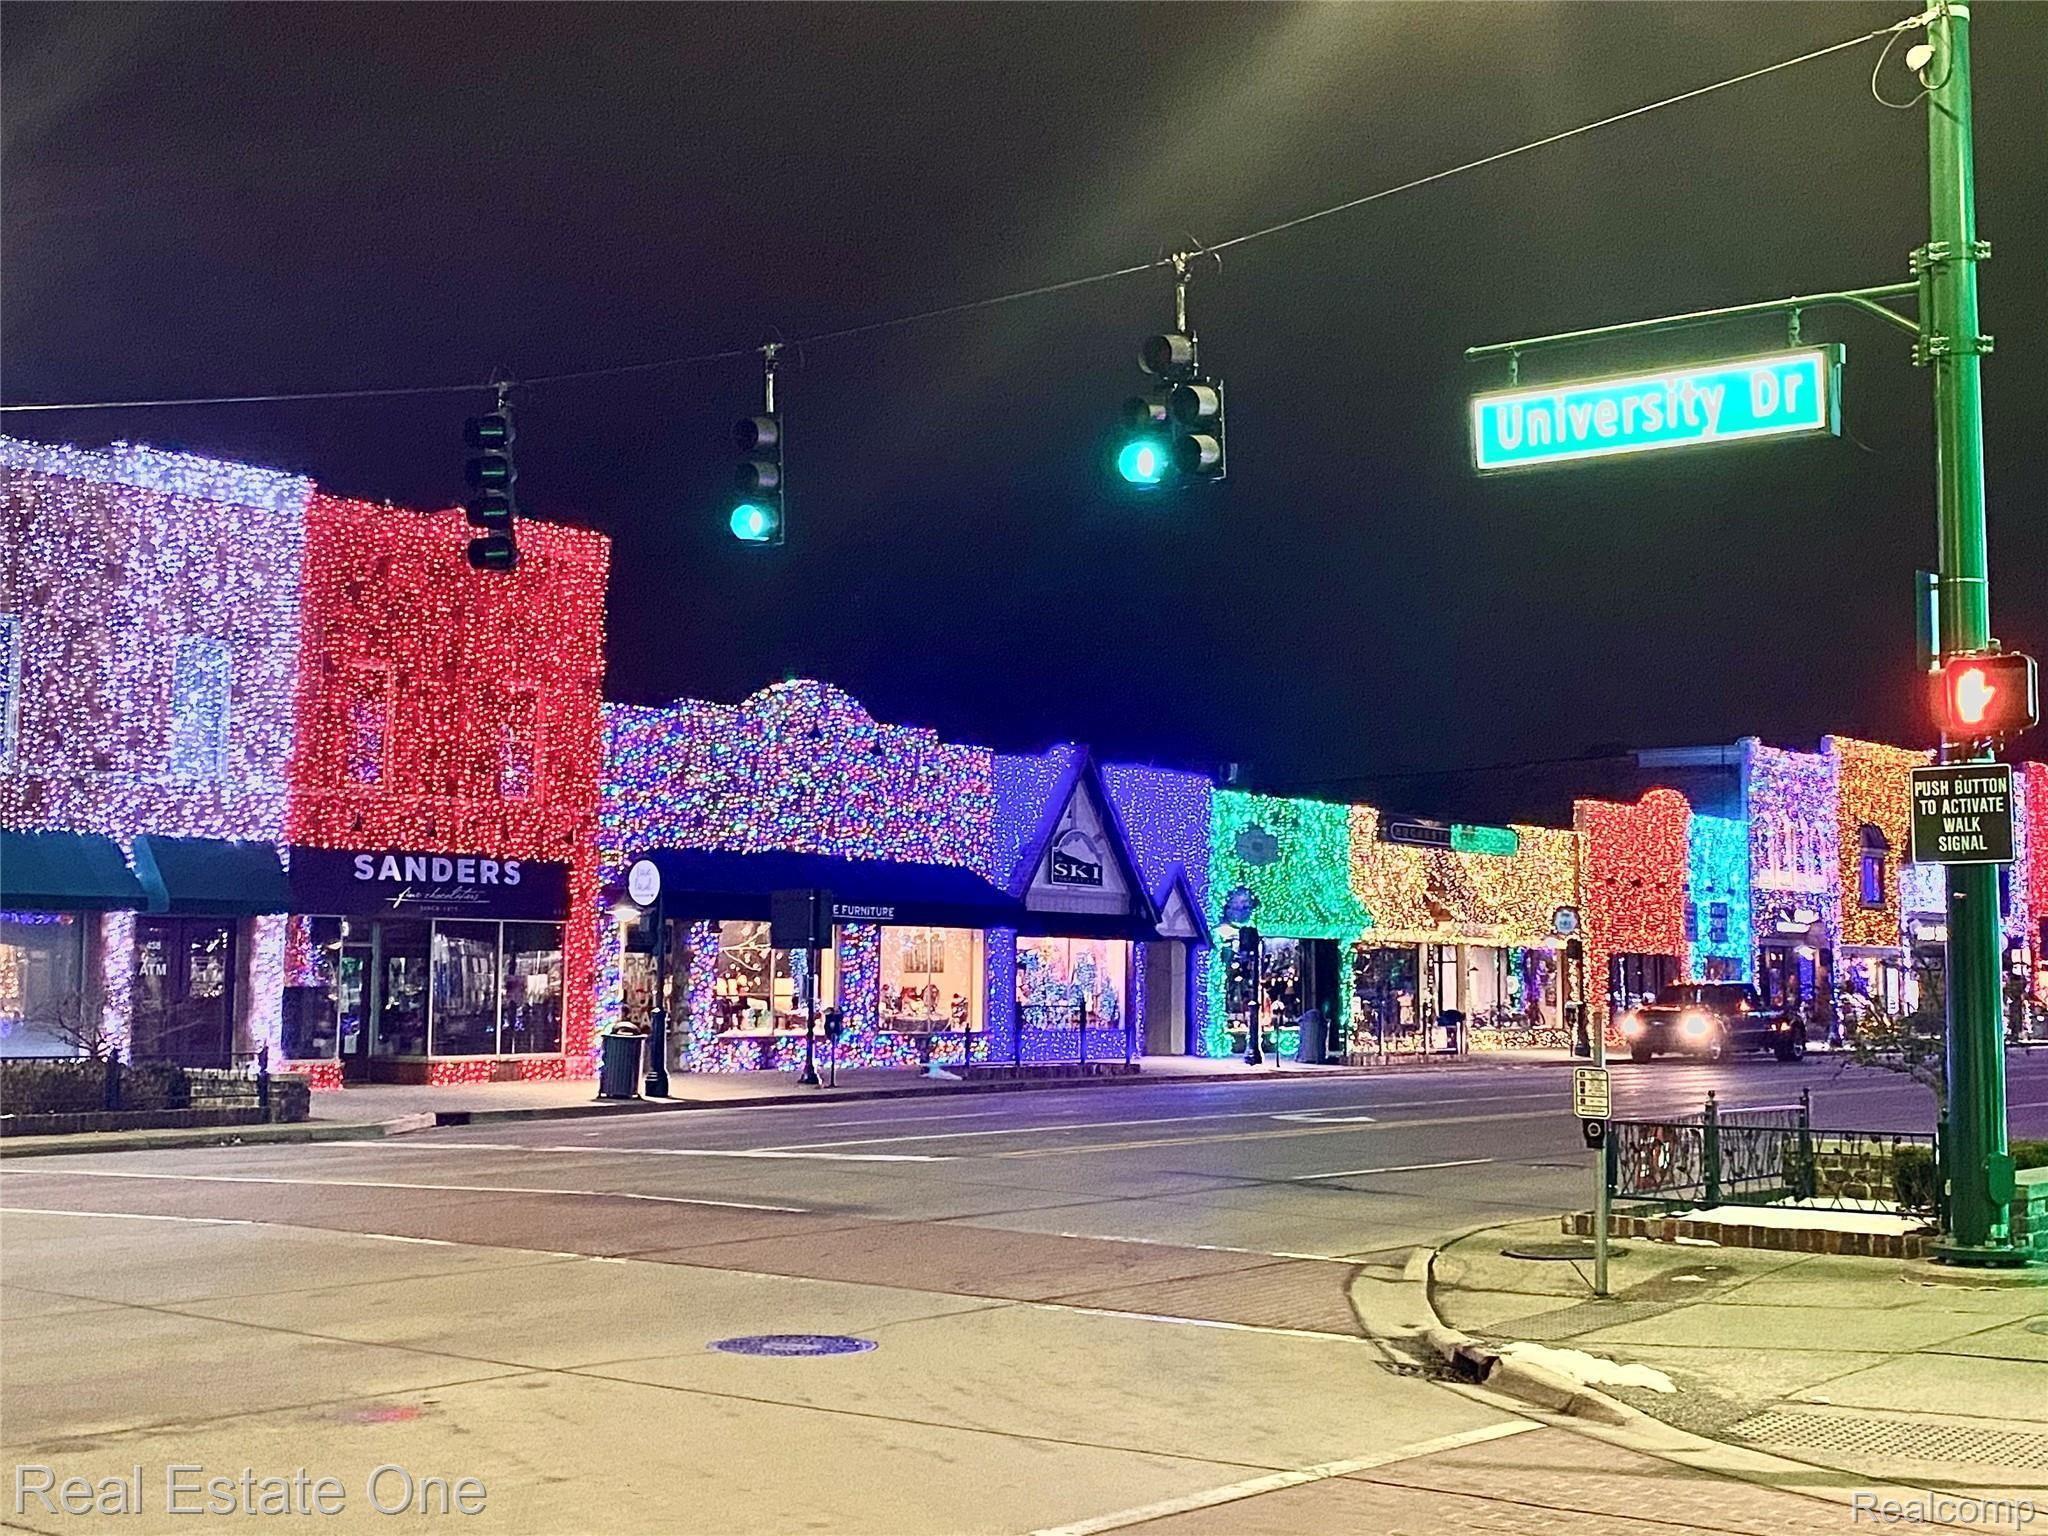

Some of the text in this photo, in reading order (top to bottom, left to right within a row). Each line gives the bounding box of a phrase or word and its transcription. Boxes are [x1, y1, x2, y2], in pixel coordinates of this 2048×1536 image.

[1496, 369, 1804, 450] University Dr
[1914, 777, 2007, 797] PUSH BUTTON
[1919, 797, 2004, 815] TO ACTIVATE
[1943, 817, 1981, 833] WALK
[1938, 835, 1988, 852] SIGNAL
[353, 854, 521, 886] SANDERS
[1054, 863, 1100, 879] SKI
[842, 905, 895, 917] FURNITURE
[139, 963, 167, 976] ATM
